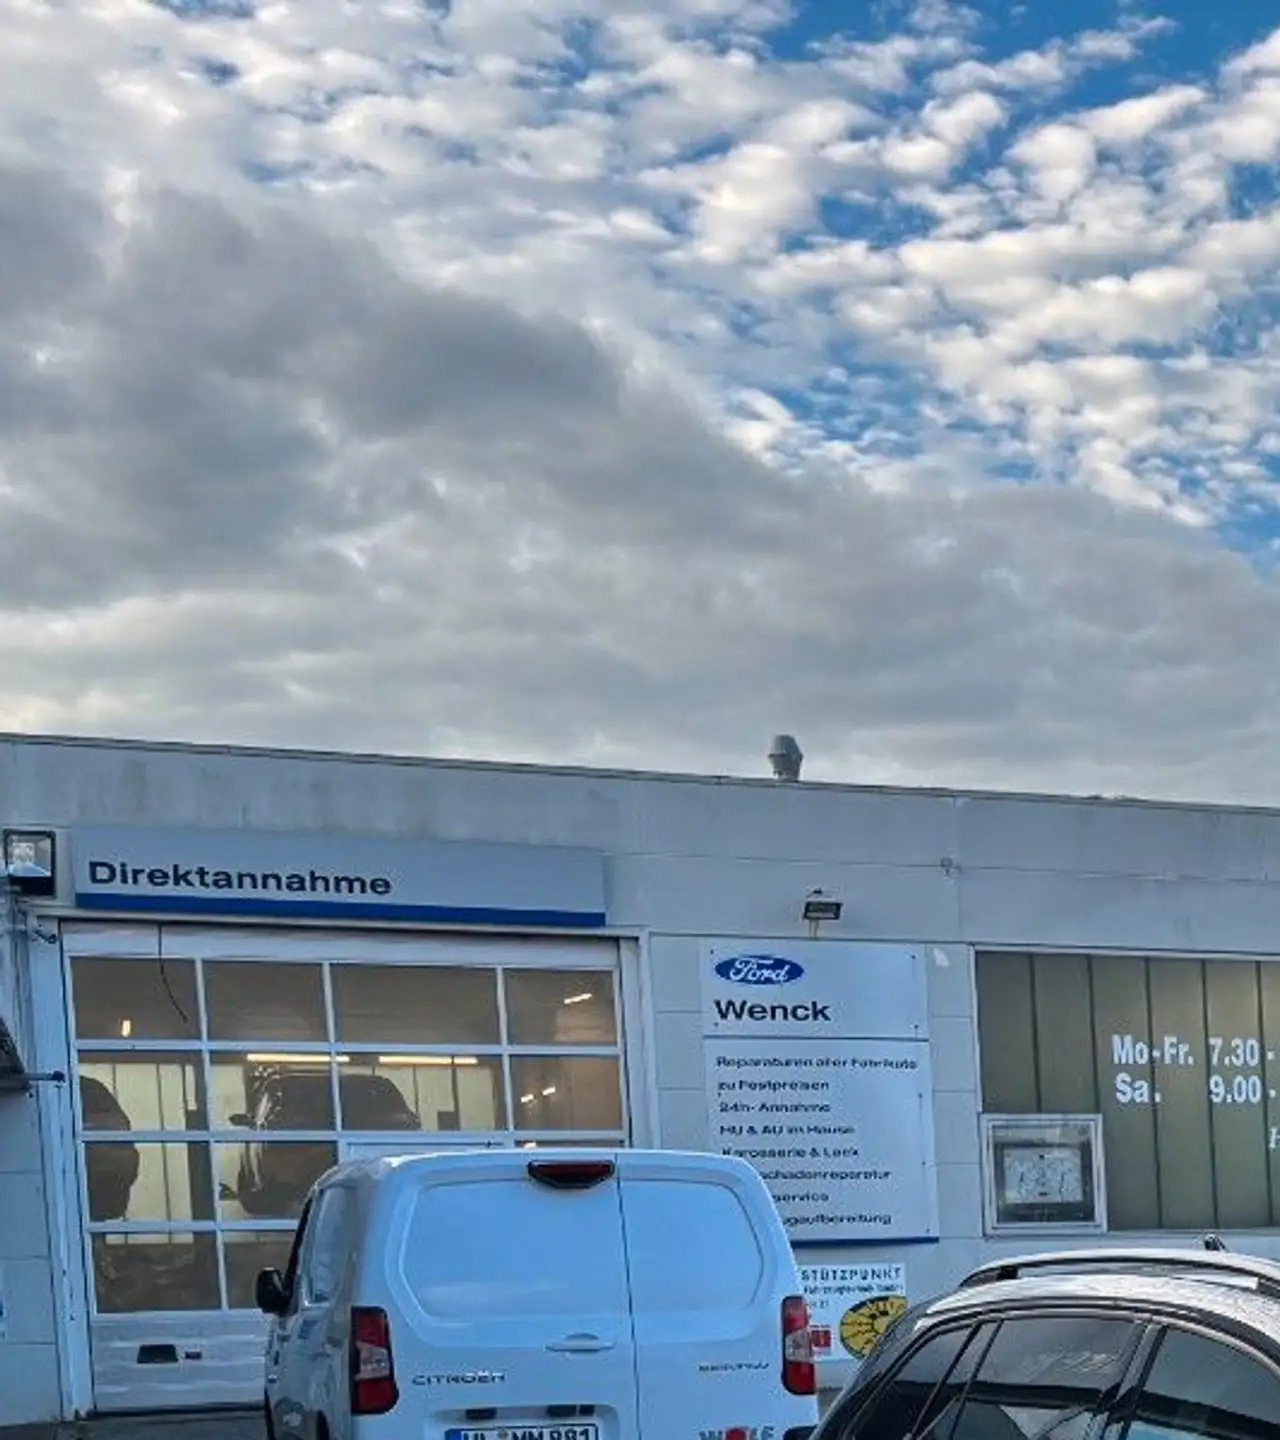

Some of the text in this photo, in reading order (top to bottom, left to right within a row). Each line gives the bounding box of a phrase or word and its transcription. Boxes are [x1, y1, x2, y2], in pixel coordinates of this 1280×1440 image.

[89, 860, 392, 895] Direktannahme
[729, 957, 791, 982] Ford
[714, 1000, 831, 1022] Wenck
[1209, 1037, 1261, 1068] 7.30
[1115, 1072, 1161, 1104] Sa.
[1209, 1075, 1262, 1104] 9.00
